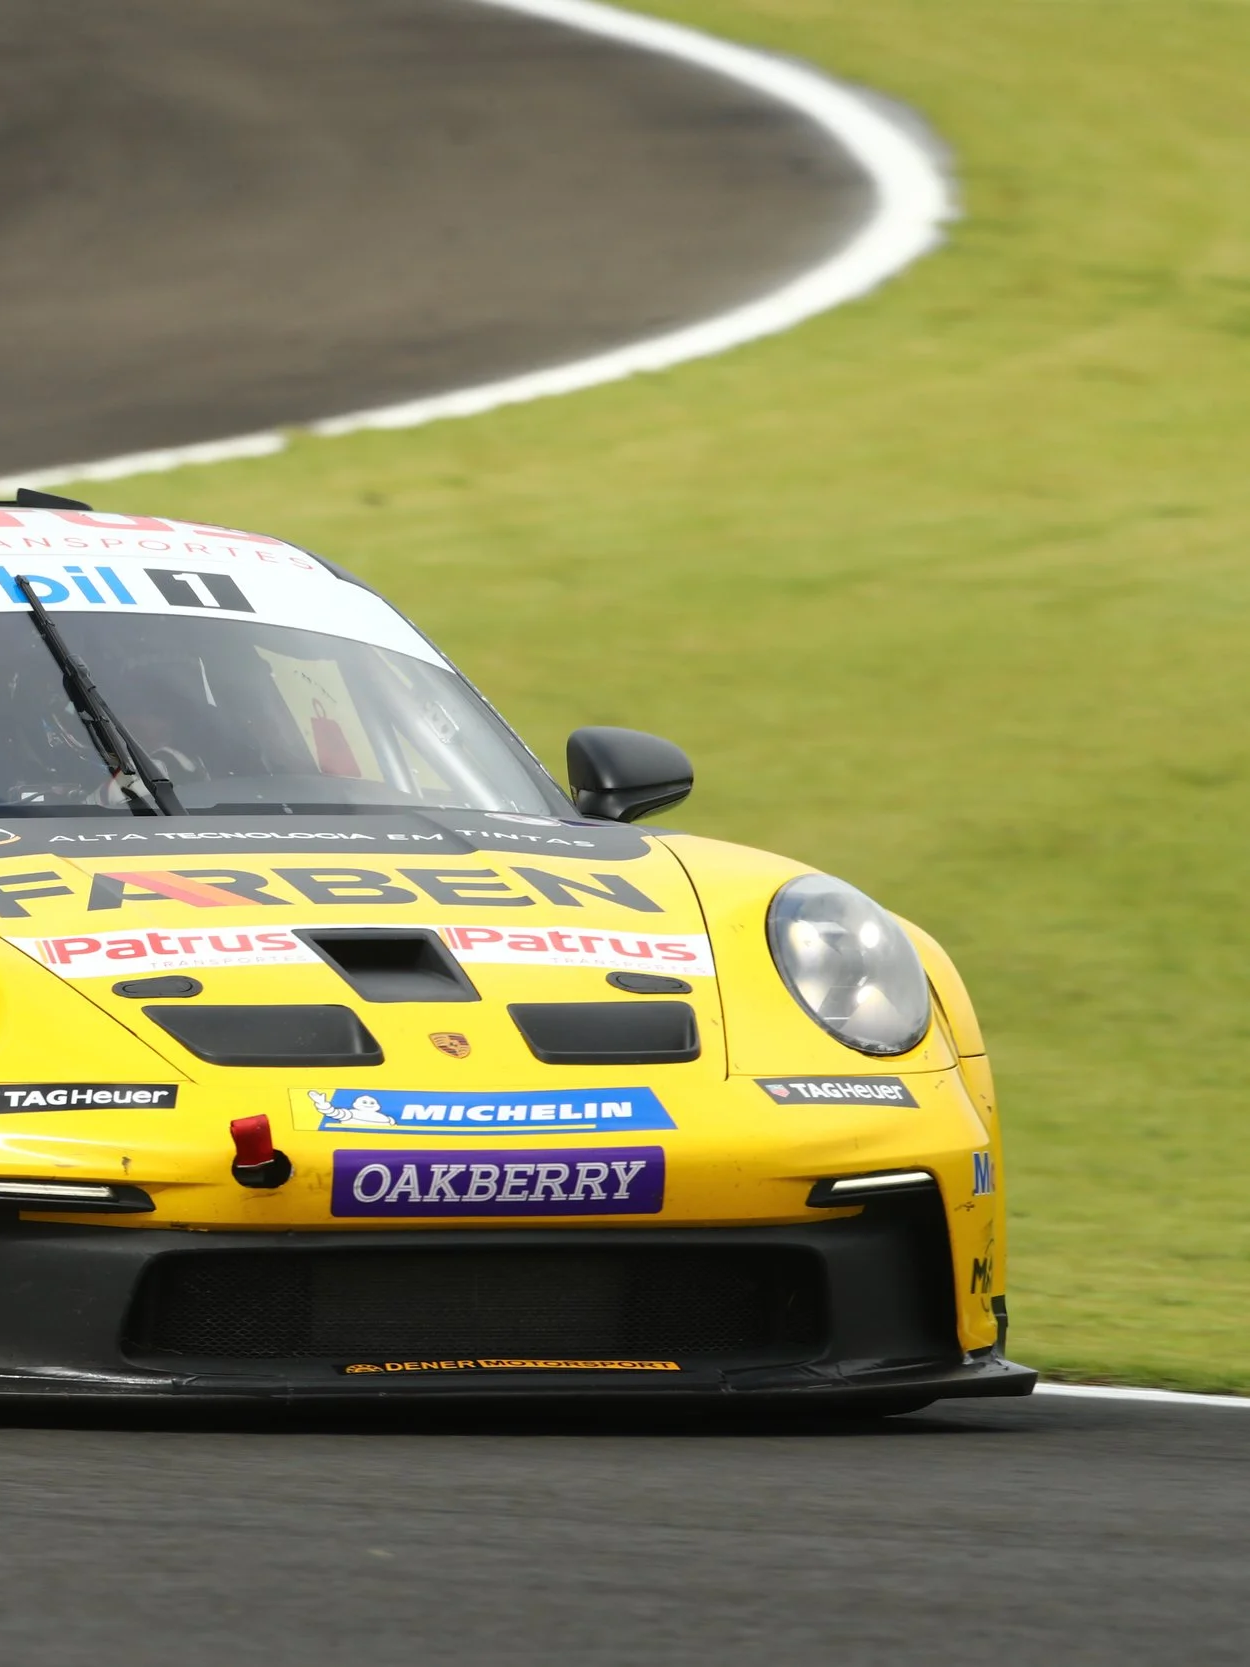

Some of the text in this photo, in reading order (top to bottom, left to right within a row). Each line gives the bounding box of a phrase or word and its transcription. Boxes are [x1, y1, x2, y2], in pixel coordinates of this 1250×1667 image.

[172, 572, 221, 607] 1
[49, 832, 148, 843] ALTA
[155, 831, 375, 840] TECNOLOGIA
[455, 829, 596, 848] TINTAS
[52, 932, 298, 964] Patrus
[453, 927, 697, 962] Patrus
[151, 955, 307, 970] TRANSPORTES
[401, 1101, 632, 1122] MICHELIN
[353, 1161, 646, 1203] OAKBERRY
[385, 1360, 675, 1372] DENER MOTORSPORT
